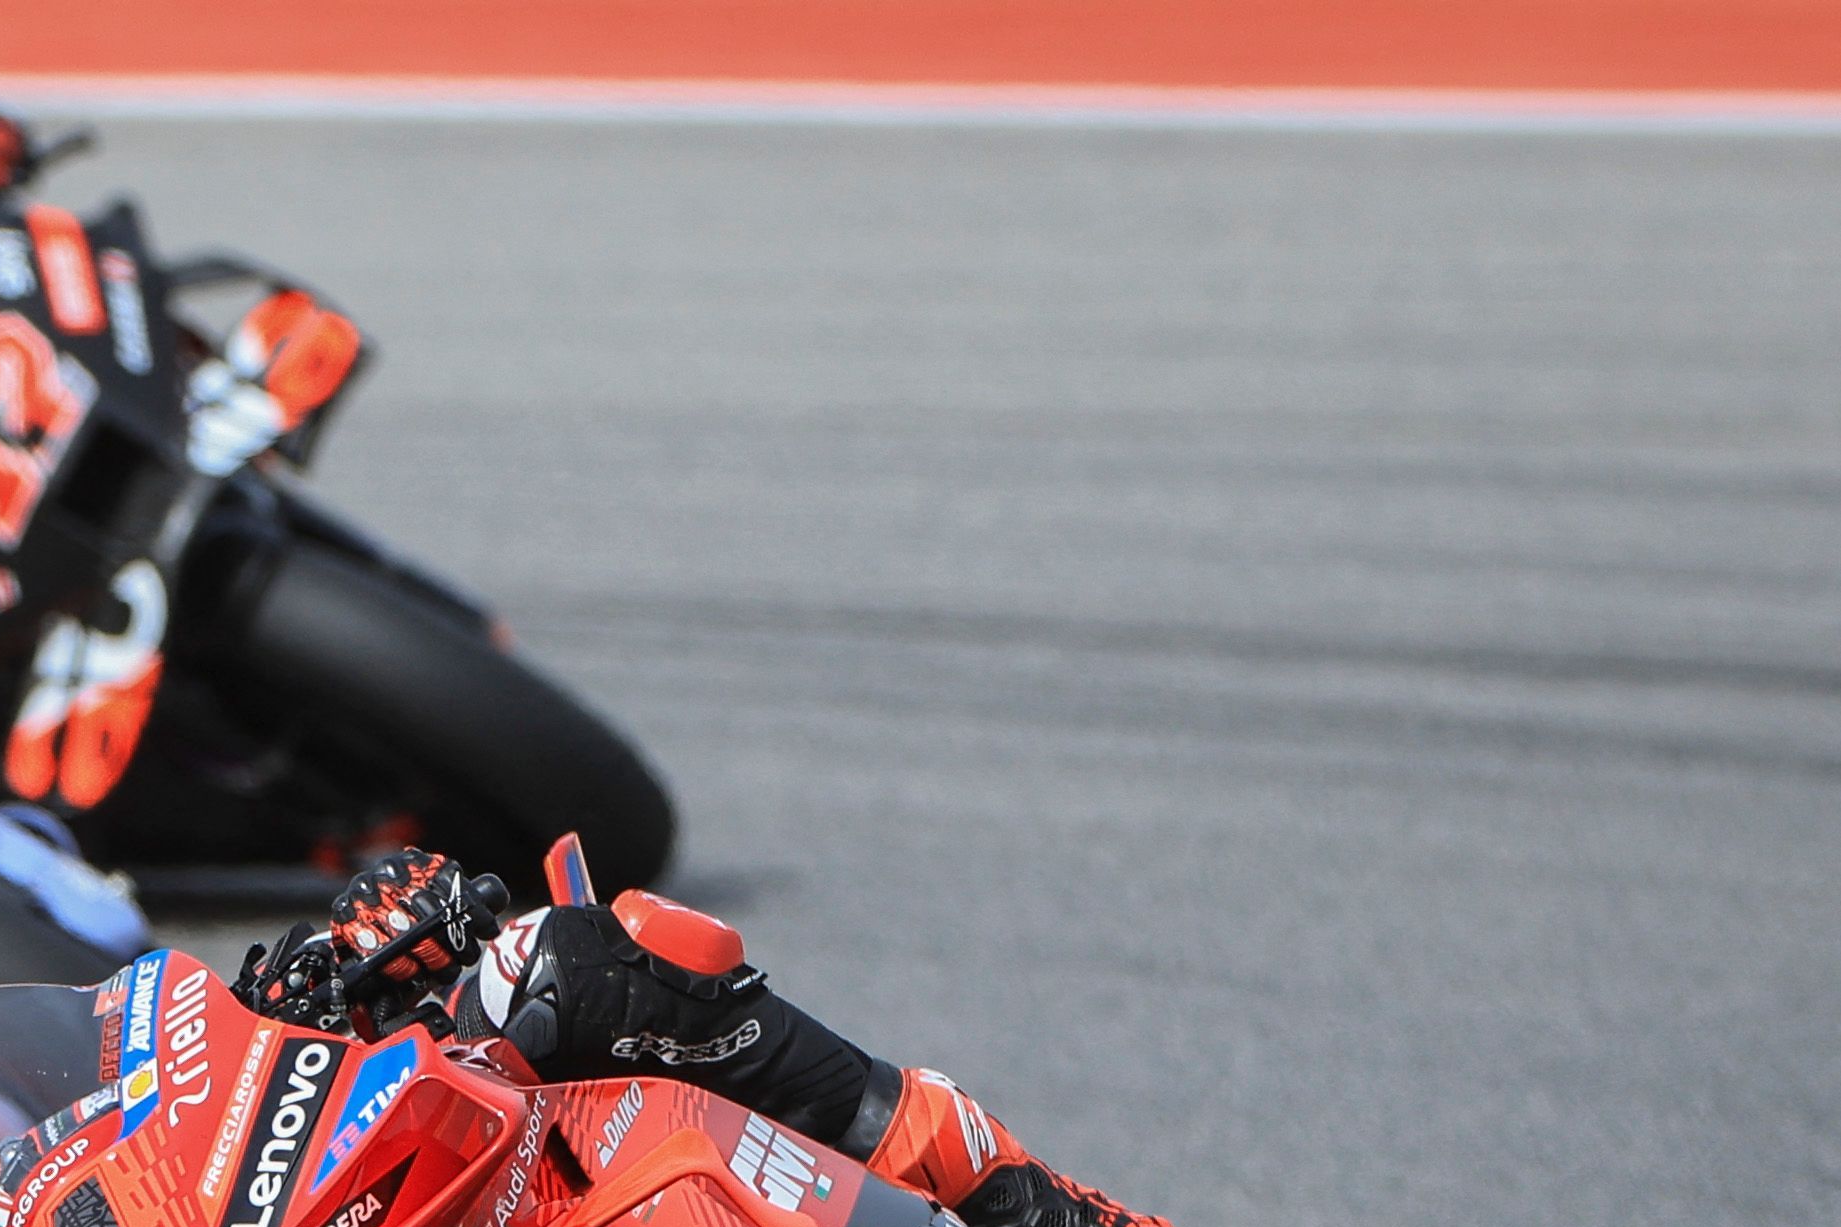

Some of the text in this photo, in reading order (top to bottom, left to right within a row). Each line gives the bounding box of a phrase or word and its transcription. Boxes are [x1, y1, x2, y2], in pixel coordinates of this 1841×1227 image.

[126, 959, 160, 1053] ADVANCE
[164, 969, 209, 1086] riello
[202, 1029, 273, 1198] FRECCIAROSSA
[358, 1066, 411, 1124] TIM
[517, 1090, 547, 1167] Sport
